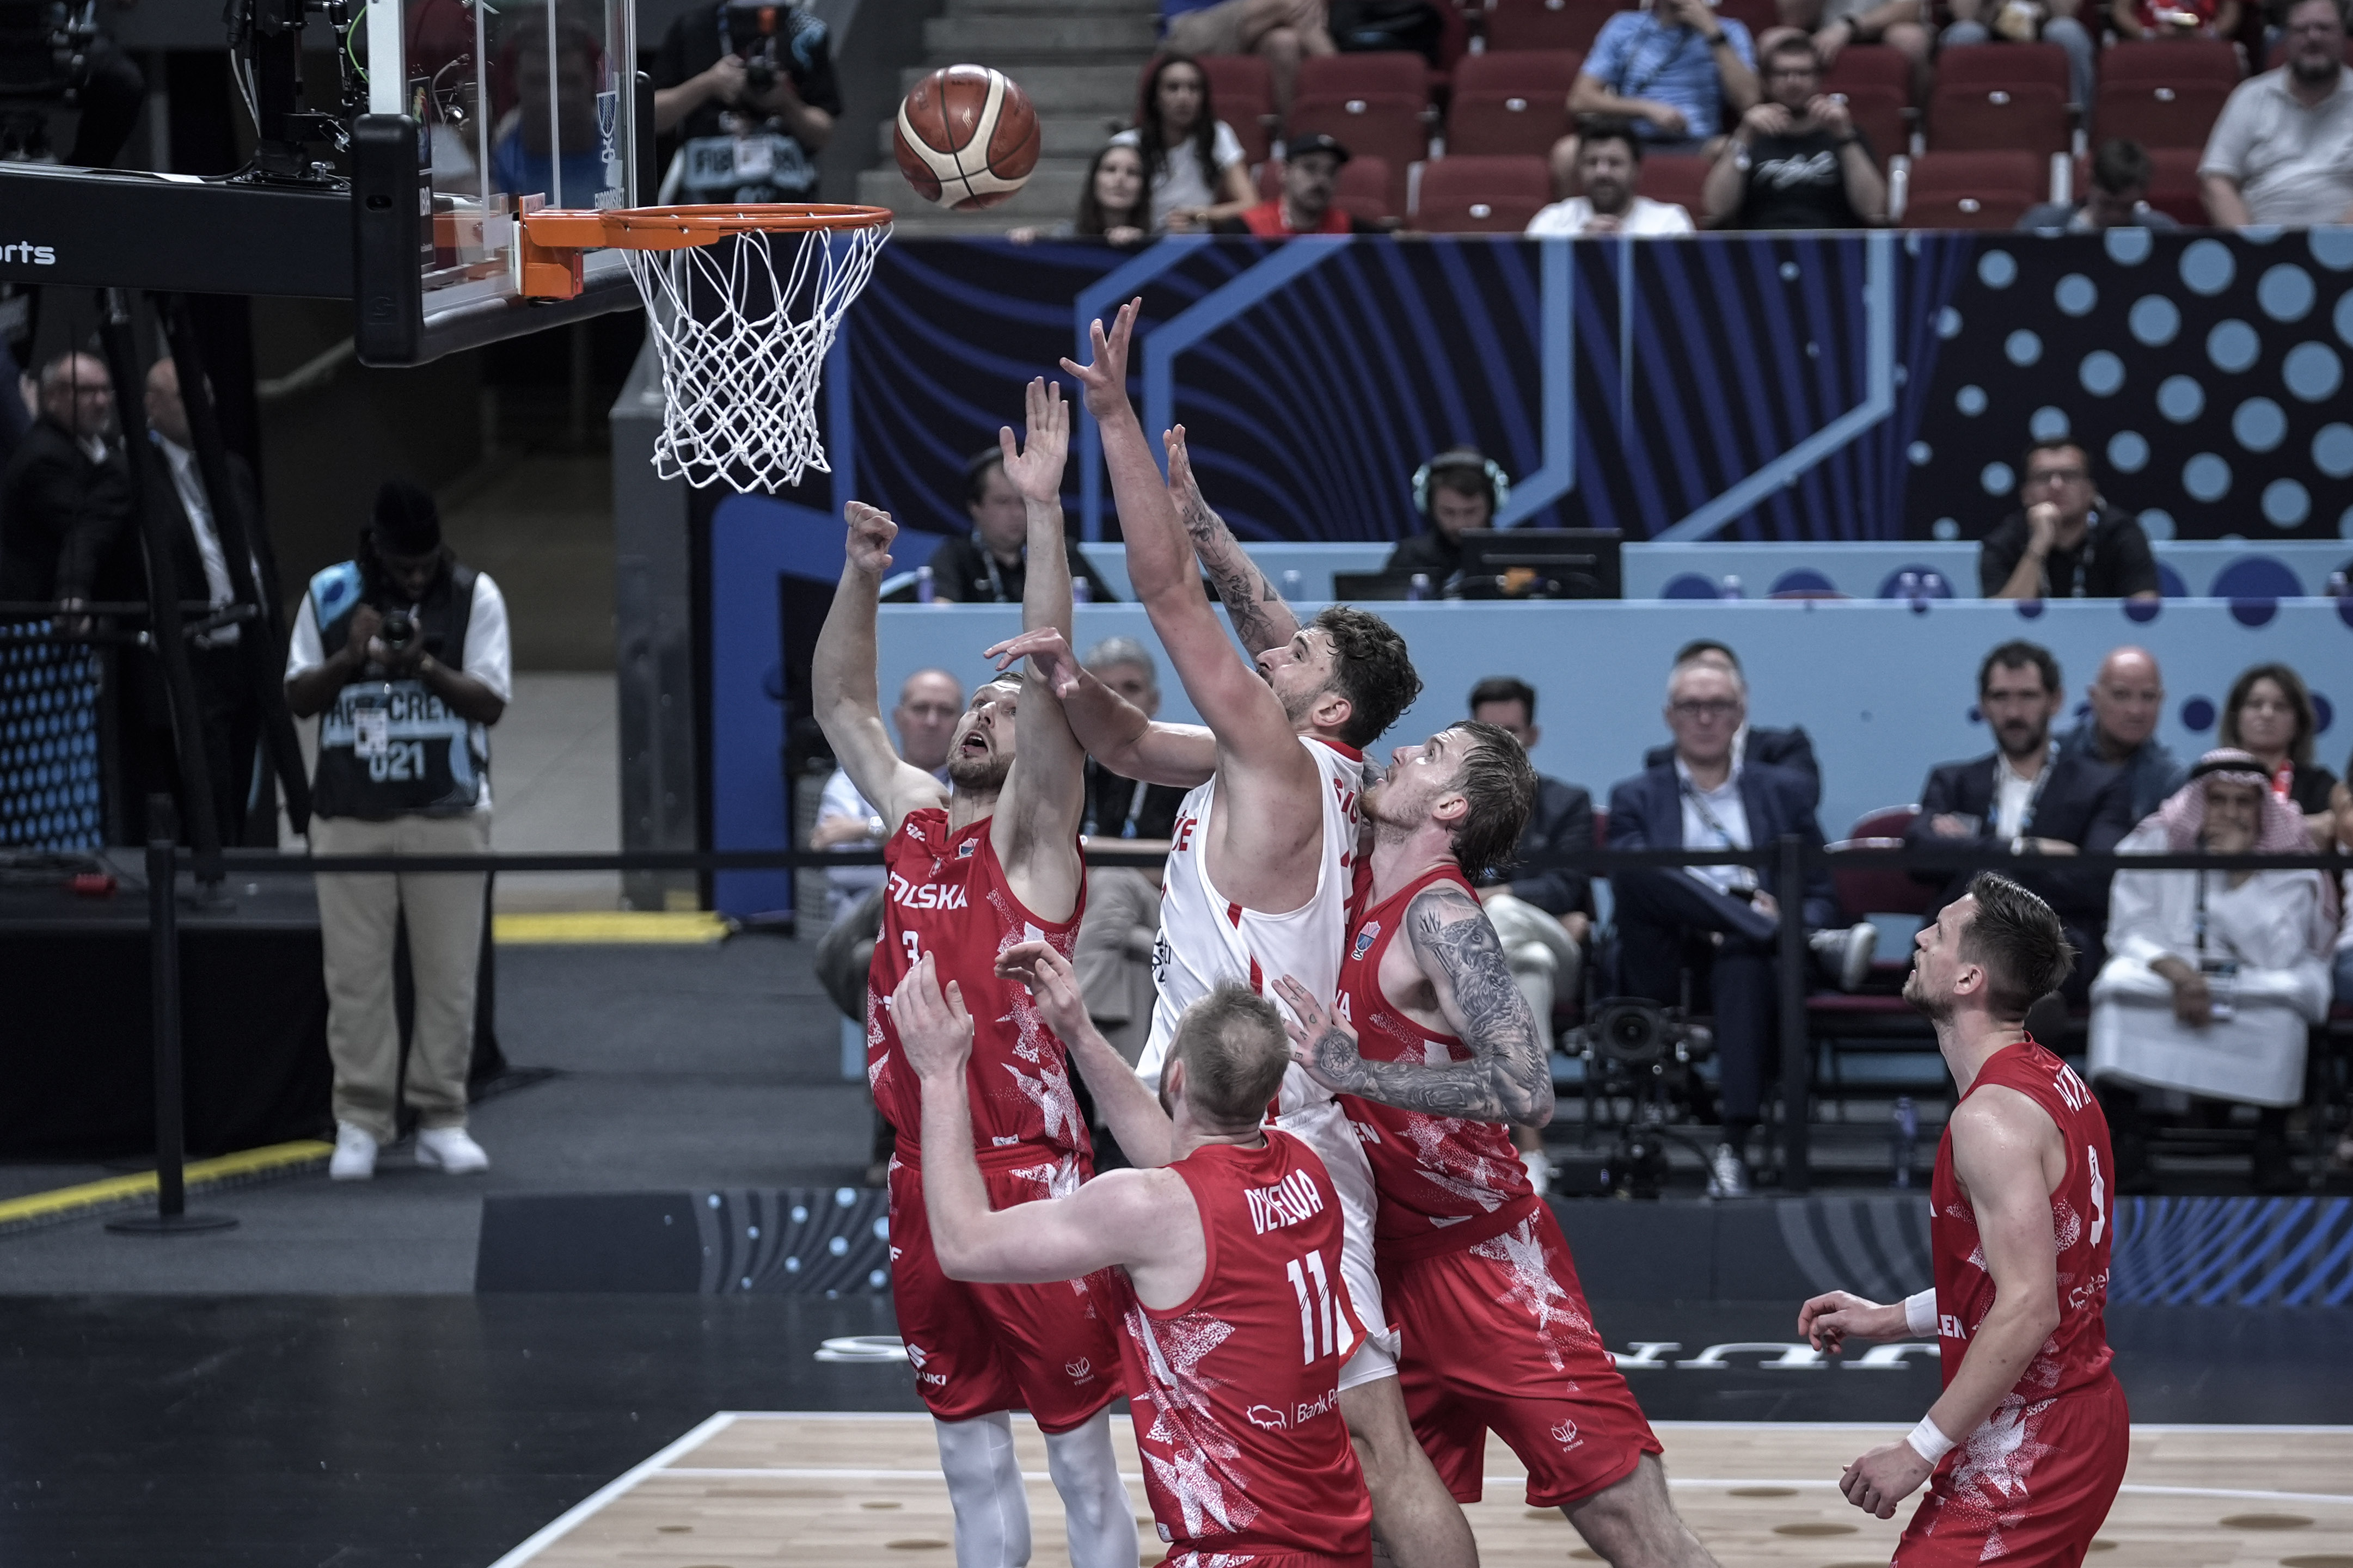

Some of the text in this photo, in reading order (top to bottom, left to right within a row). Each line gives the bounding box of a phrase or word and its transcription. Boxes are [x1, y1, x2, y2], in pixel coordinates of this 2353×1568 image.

[0, 240, 56, 265] rts
[1243, 1169, 1323, 1235] DZIEWA
[889, 1244, 903, 1263] F
[1286, 1250, 1333, 1366] 11
[1938, 1314, 1967, 1340] EN
[1297, 1394, 1328, 1424] Bank
